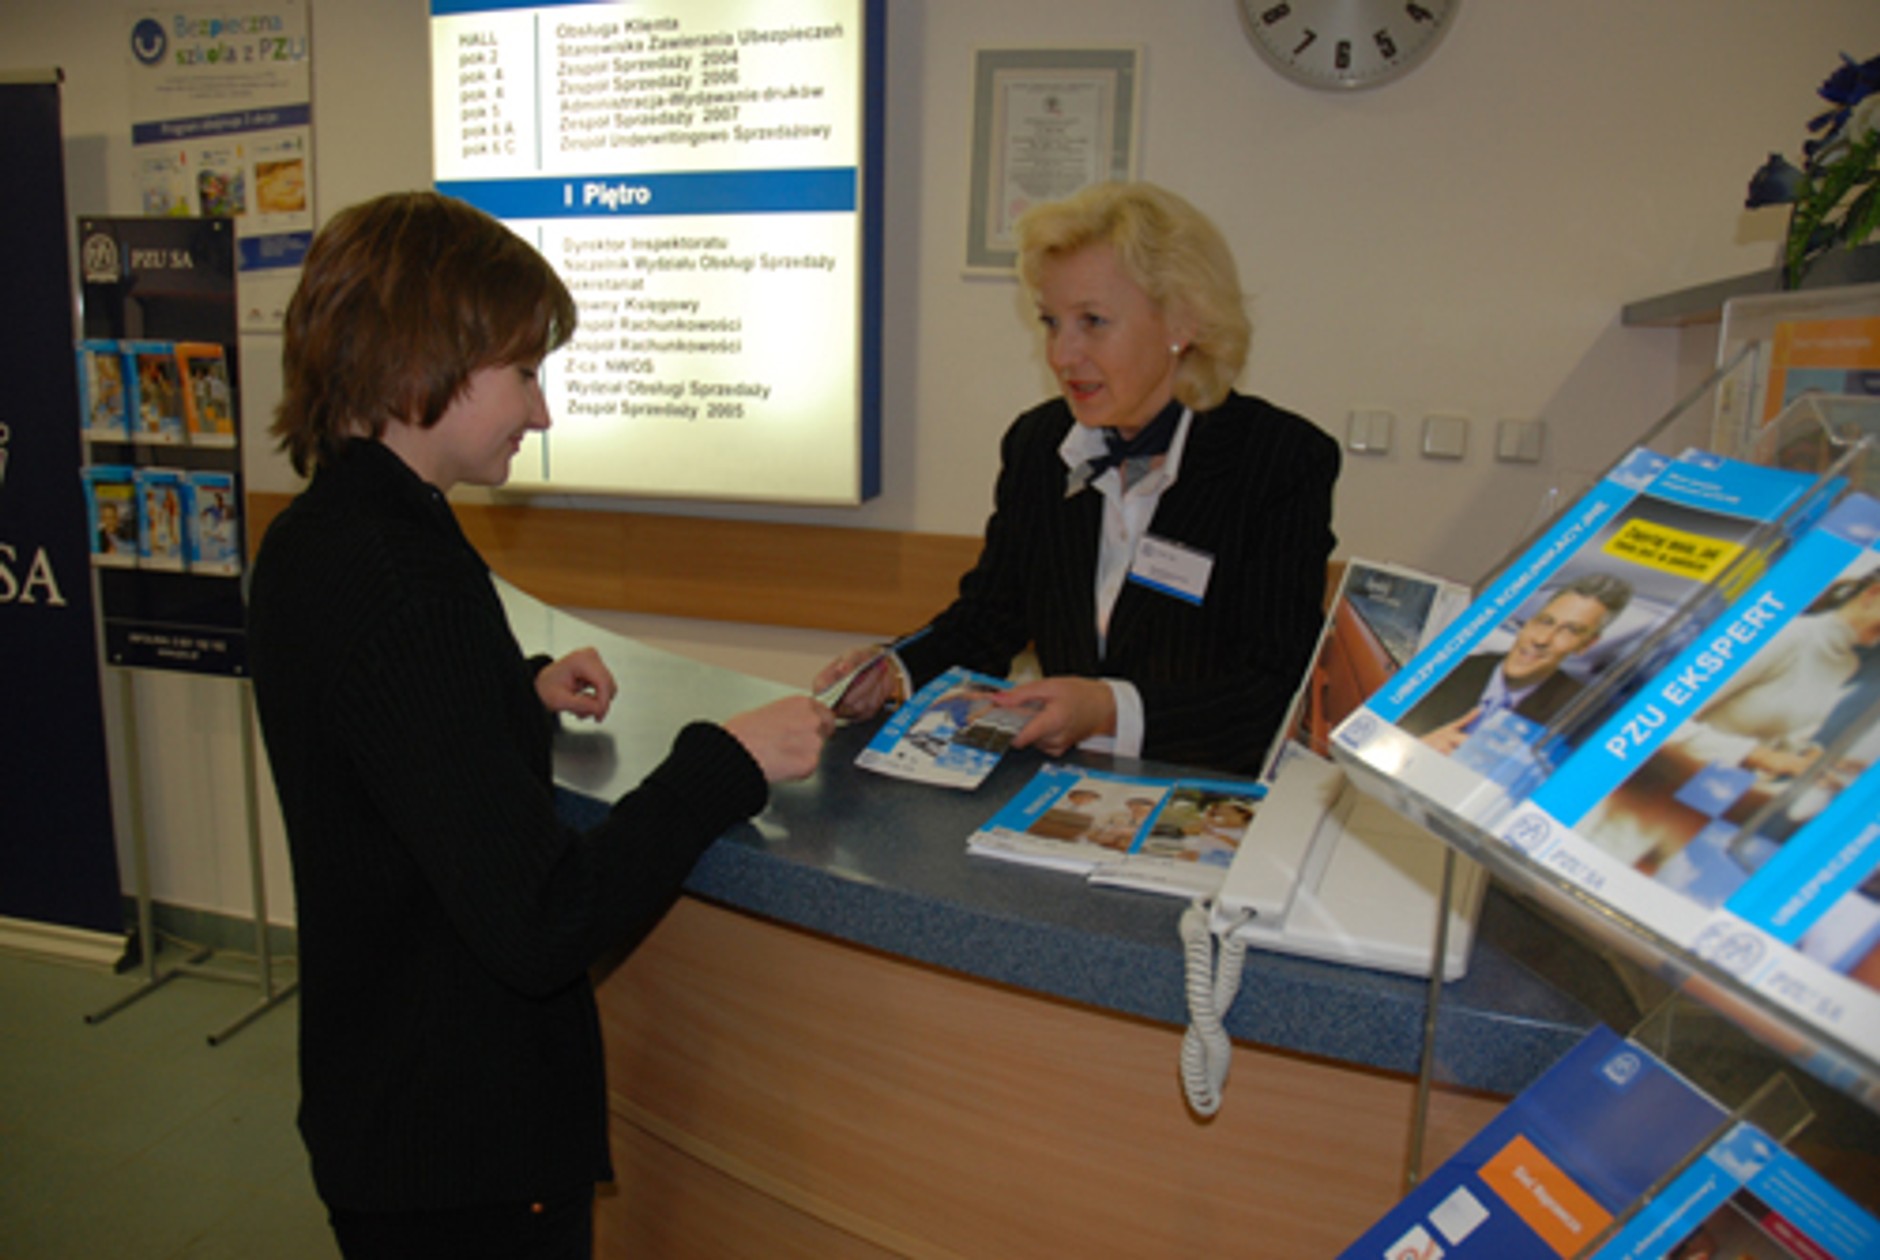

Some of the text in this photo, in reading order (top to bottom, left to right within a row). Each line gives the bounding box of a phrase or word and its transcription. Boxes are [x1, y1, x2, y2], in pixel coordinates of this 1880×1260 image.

[1262, 3, 1291, 26] 8
[1405, 2, 1434, 24] 4
[556, 17, 679, 39] Obsługa Klienta
[648, 32, 734, 51] Zawierania
[738, 23, 845, 46] Ubezpieczeń
[259, 37, 306, 62] PZU
[458, 33, 498, 47] HALL
[1293, 30, 1317, 56] 7
[1374, 30, 1398, 60] 5
[612, 55, 693, 74] Sprzedaży
[700, 49, 739, 67] 2004
[1334, 40, 1351, 69] 6
[612, 74, 693, 93] Sprzedaży
[701, 68, 740, 86] 2006
[613, 109, 694, 129] Sprzedaży
[702, 105, 740, 123] 2007
[563, 183, 652, 211] I Piętro
[630, 236, 728, 253] Inspektoratu
[131, 247, 194, 270] PZU SA
[699, 253, 755, 272] Obsługi
[758, 253, 837, 272] Sprzedaży
[623, 297, 700, 314] Księgowy
[619, 316, 742, 333] Rachunkowości
[619, 336, 742, 353] Rachunkowości
[626, 379, 685, 399] Obsługi
[688, 380, 772, 400] Sprzedaży
[620, 400, 699, 421] Sprzedaży
[705, 402, 746, 420] 2005
[1605, 590, 1786, 760] PZU EKSPERT
